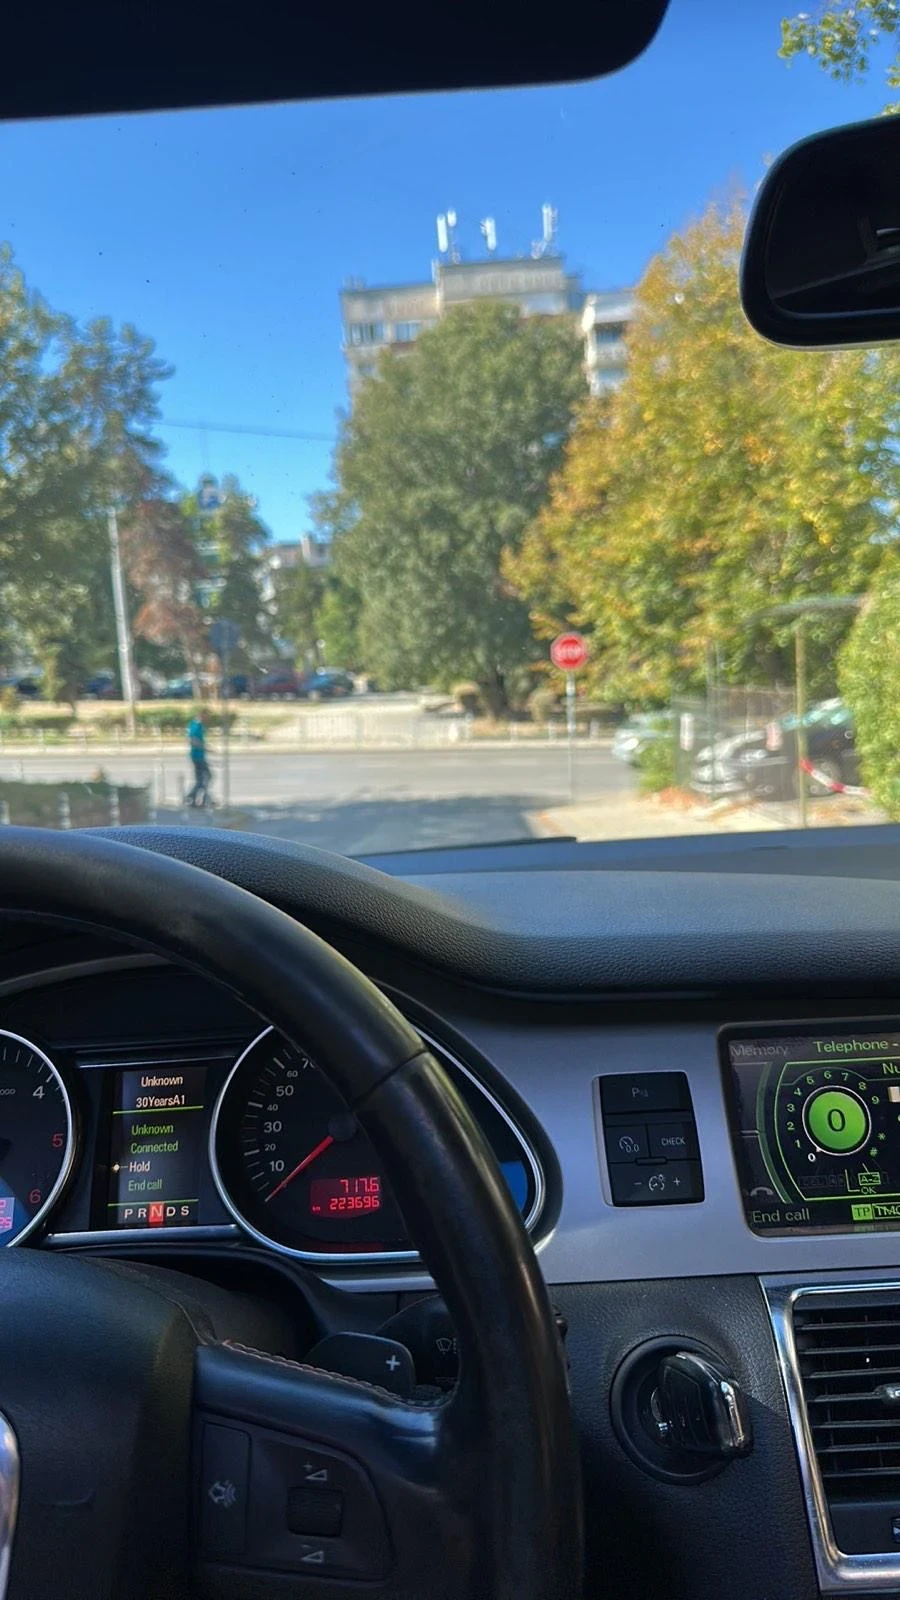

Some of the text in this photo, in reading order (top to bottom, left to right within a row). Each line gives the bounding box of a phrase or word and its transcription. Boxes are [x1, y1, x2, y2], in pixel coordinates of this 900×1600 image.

[731, 1044, 789, 1058] Memory
[813, 1040, 889, 1054] Telephone
[287, 1069, 298, 1078] 60
[824, 1071, 832, 1080] 6
[141, 1076, 183, 1087] Unknown
[859, 1082, 867, 1090] 8
[32, 1085, 45, 1099] 4
[276, 1085, 294, 1097] 50
[794, 1088, 801, 1096] 4
[136, 1094, 185, 1108] 30YearsA1
[872, 1096, 880, 1104] 9
[267, 1103, 279, 1111] 40
[786, 1103, 796, 1113] 3
[786, 1121, 795, 1131] 2
[827, 1108, 846, 1132] 0
[131, 1124, 174, 1136] Unknown
[263, 1121, 282, 1133] 30
[52, 1133, 64, 1148] 5
[661, 1137, 686, 1147] CHECK
[795, 1139, 801, 1148] 1
[130, 1141, 179, 1154] Connected
[264, 1143, 276, 1152] 20
[807, 1153, 816, 1162] 0
[129, 1161, 151, 1173] Hold
[269, 1160, 285, 1171] 10
[128, 1179, 163, 1191] End call
[340, 1177, 380, 1193] 717.6
[860, 1186, 877, 1194] OK
[29, 1189, 41, 1204] 6
[329, 1196, 380, 1210] 223696
[124, 1205, 190, 1219] P R N D S
[752, 1208, 810, 1223] End call
[854, 1207, 870, 1216] TP
